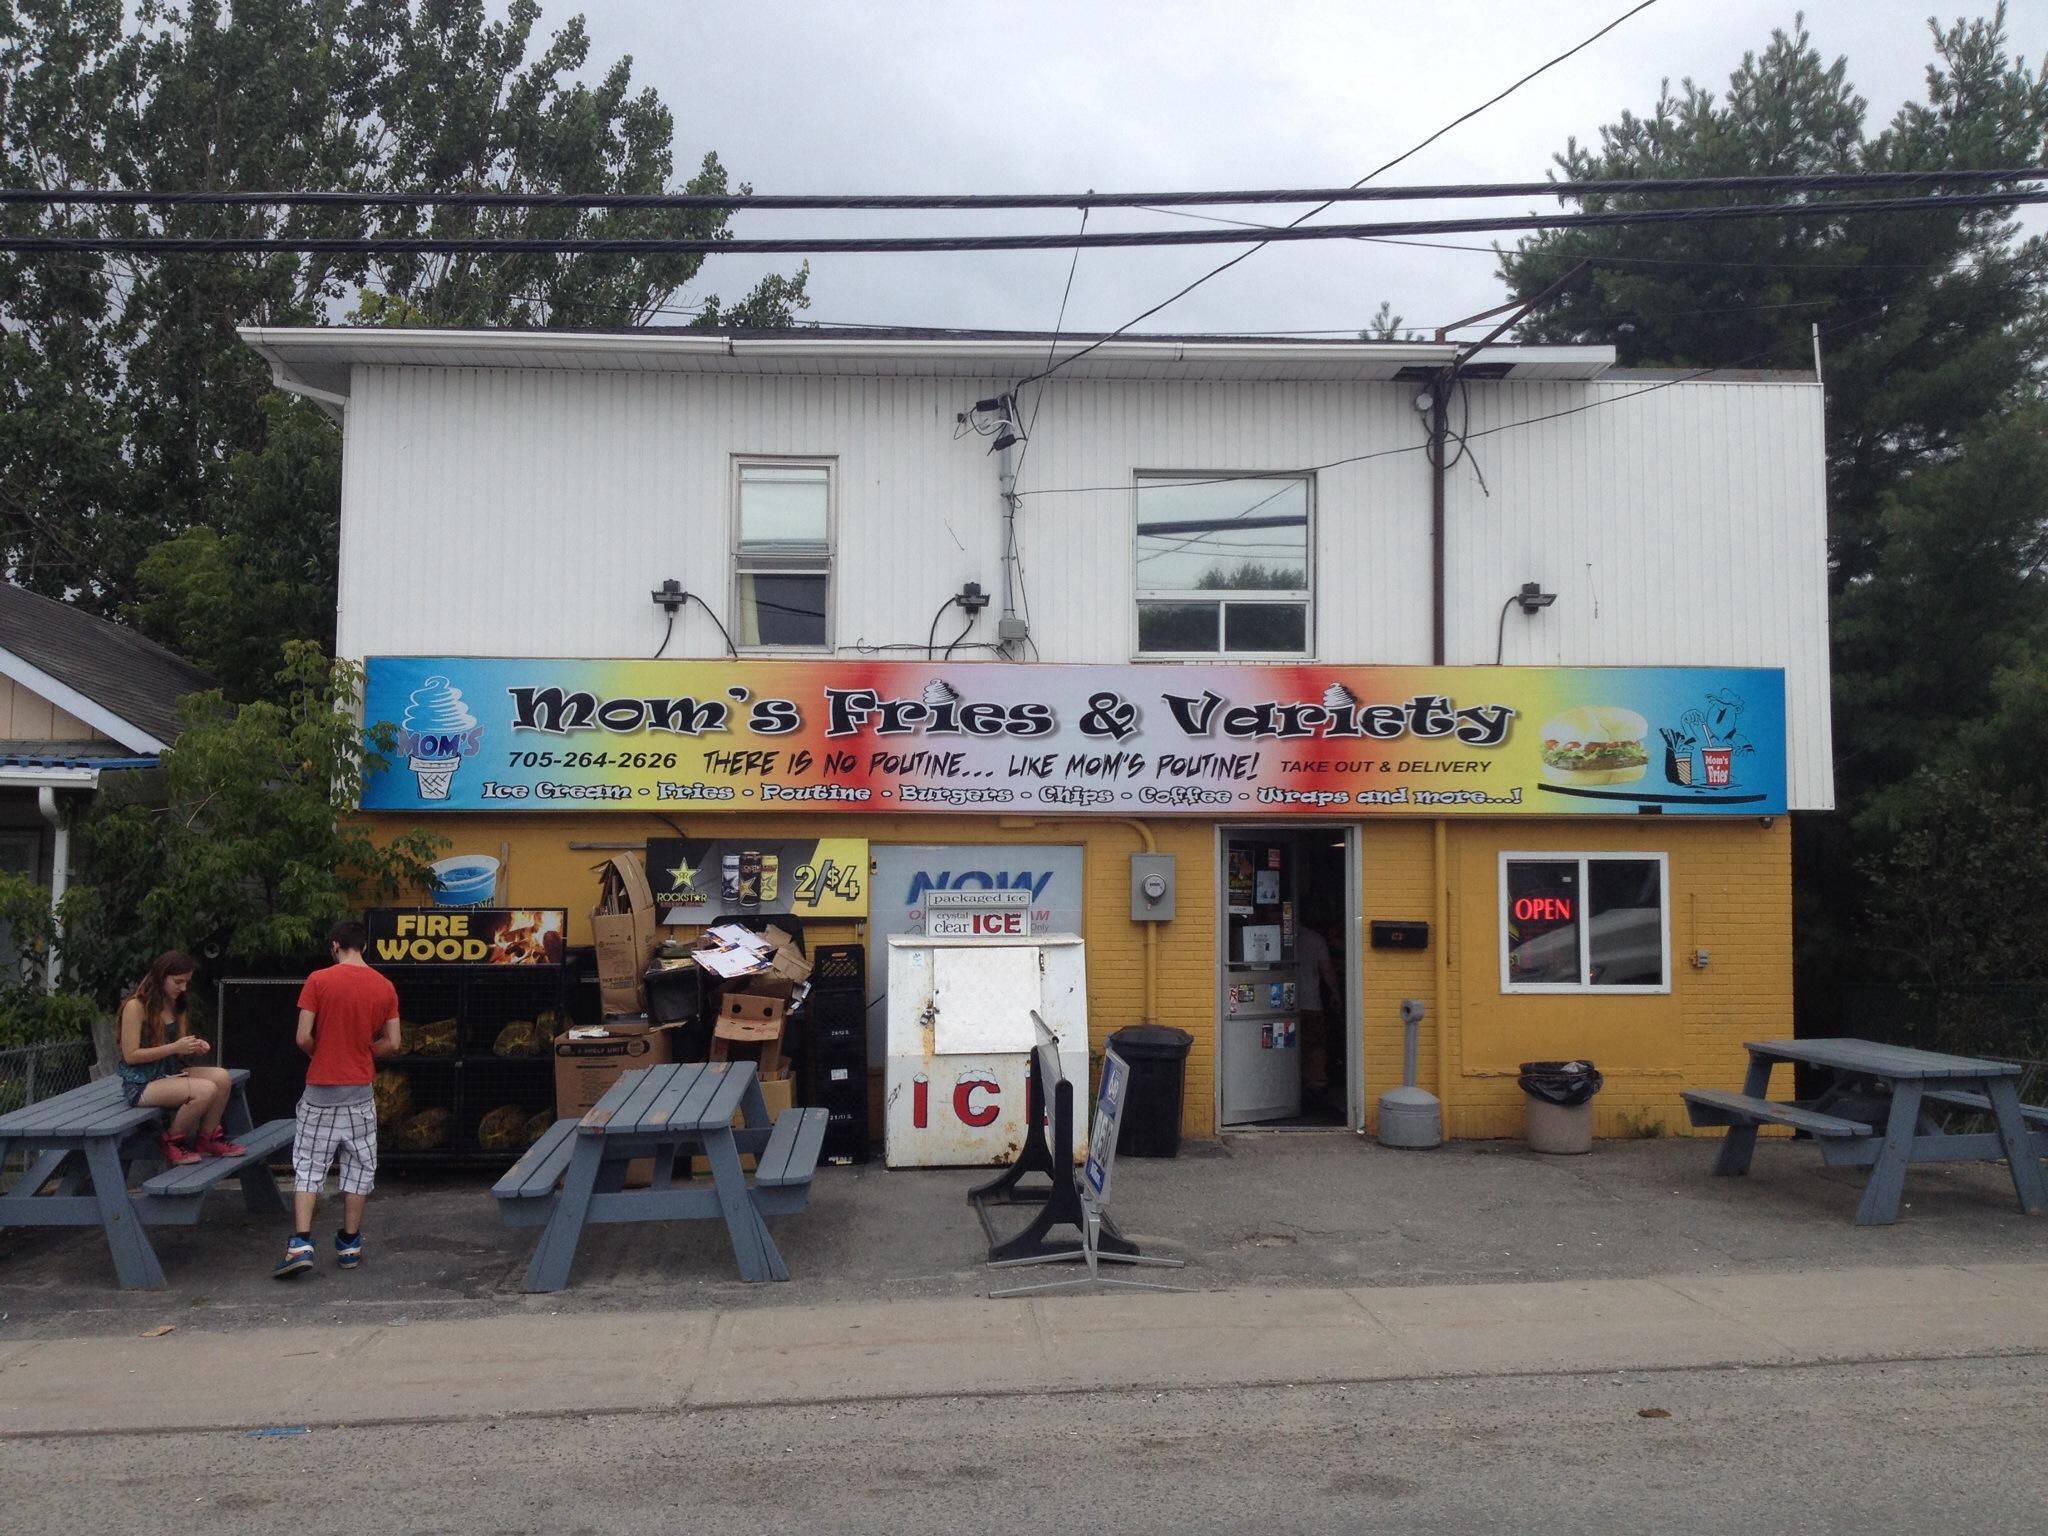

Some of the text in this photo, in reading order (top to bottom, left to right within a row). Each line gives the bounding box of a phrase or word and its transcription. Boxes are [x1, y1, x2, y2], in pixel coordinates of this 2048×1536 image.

[506, 685, 1516, 746] Mom's Fries & Variety
[397, 727, 484, 757] MOM'S
[508, 752, 677, 768] 705-264-2626
[704, 750, 1260, 781] THERE IS NO POUTINE... LIKE MOM'S POUTINE!
[1281, 761, 1491, 773] TAKE OUT & DELIVERY
[1705, 755, 1729, 765] Mom's
[1707, 765, 1729, 783] Fries
[481, 782, 1522, 806] Ice Cream Fries Poutine Burgers Chips Coffee Wraps and more...!
[794, 860, 860, 907] 2/$4
[905, 870, 1054, 906] NOW
[934, 892, 1027, 905] packaged ice
[1515, 898, 1571, 920] OPEN
[397, 915, 470, 937] FIRE
[935, 912, 1022, 934] clear ICE
[937, 911, 969, 921] crystal
[377, 939, 488, 961] WOOD
